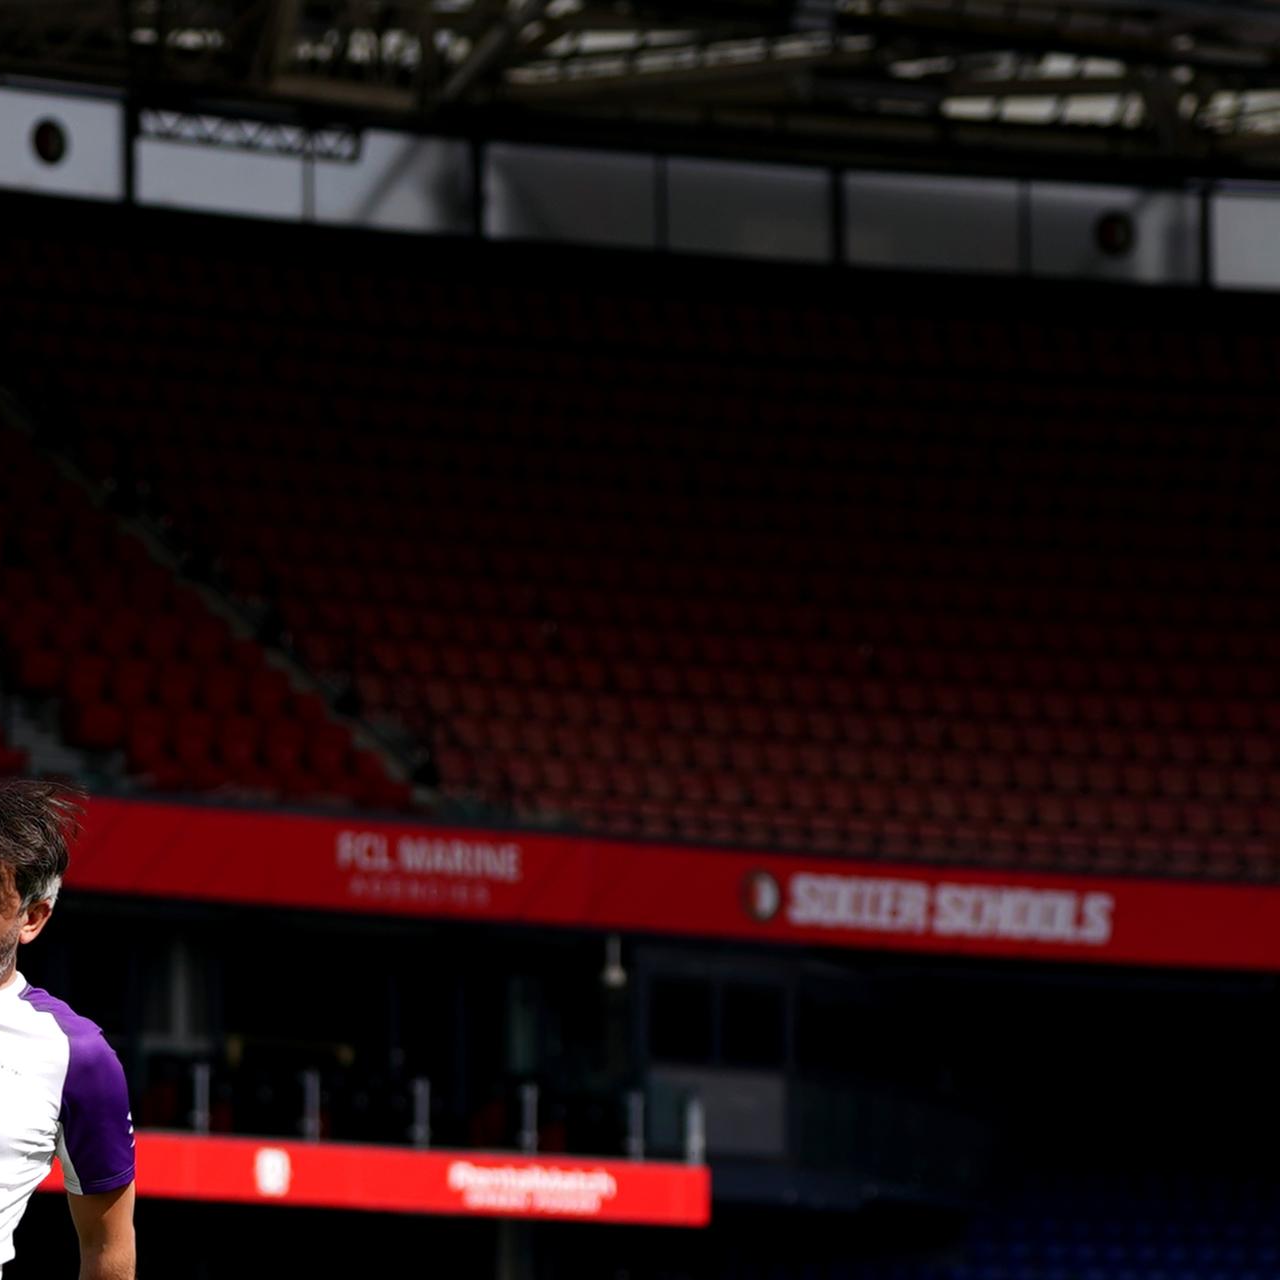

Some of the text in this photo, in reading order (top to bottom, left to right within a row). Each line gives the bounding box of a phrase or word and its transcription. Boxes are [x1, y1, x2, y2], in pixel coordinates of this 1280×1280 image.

[397, 834, 523, 884] MARINE
[788, 873, 1114, 943] SOCCER SCHOOLS
